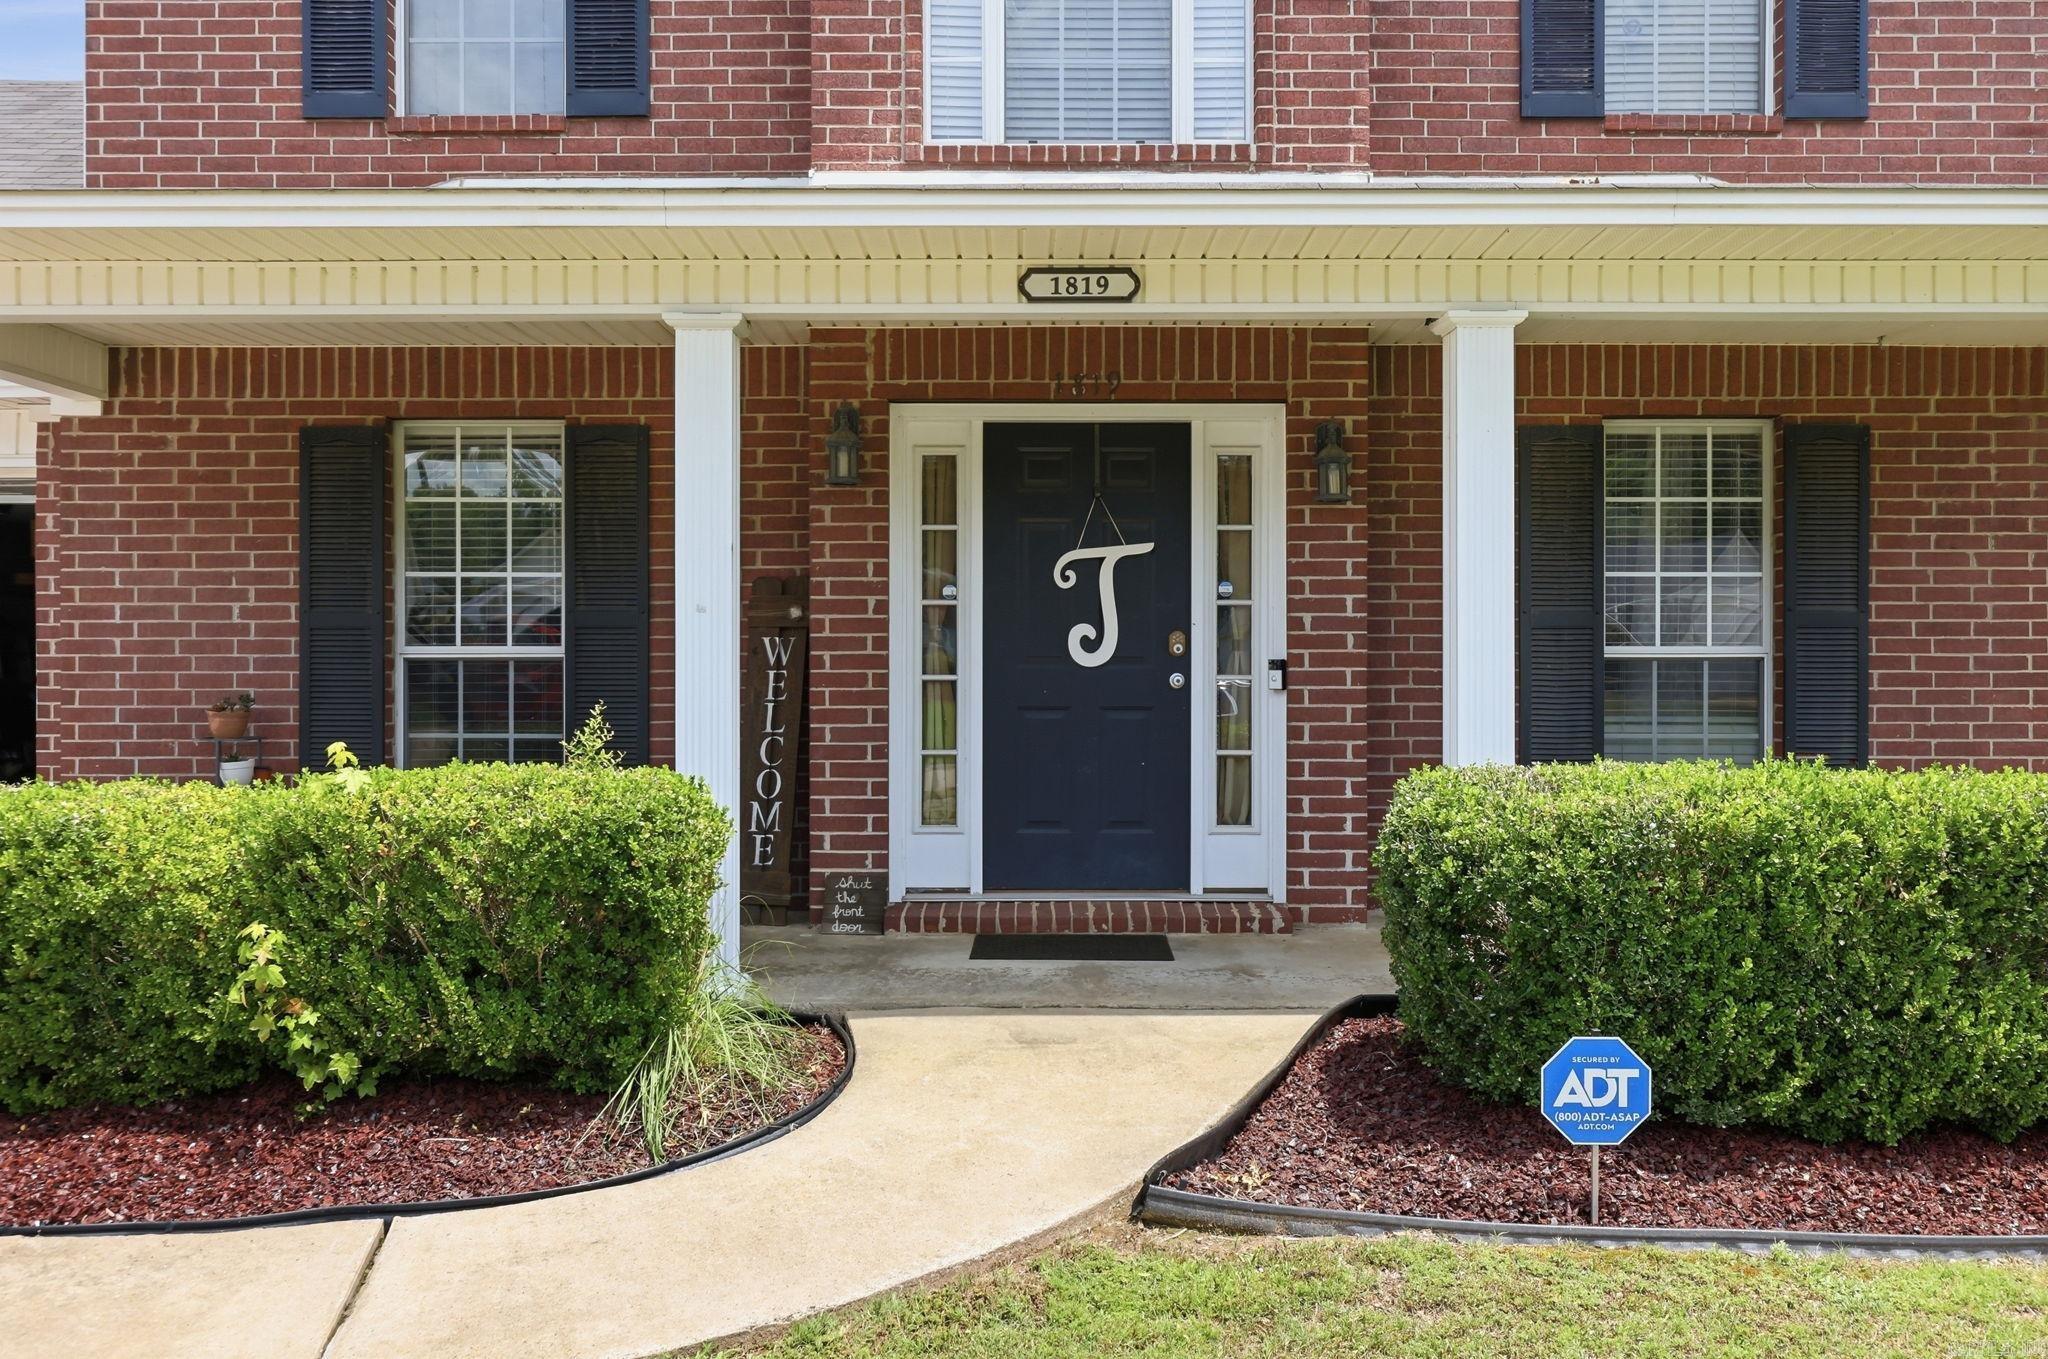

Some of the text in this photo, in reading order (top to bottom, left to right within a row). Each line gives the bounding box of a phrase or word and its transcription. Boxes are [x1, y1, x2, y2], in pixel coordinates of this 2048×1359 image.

[1049, 275, 1110, 296] 1819
[1055, 370, 1121, 400] 1819
[748, 636, 796, 867] WELCOME
[835, 875, 872, 889] shut
[835, 890, 857, 904] the
[832, 904, 865, 919] front
[831, 919, 865, 933] door
[1553, 1068, 1640, 1108] ADT
[1554, 1111, 1640, 1123] (800) ADT-ASAP
[1577, 1123, 1615, 1131] ADT.COM
